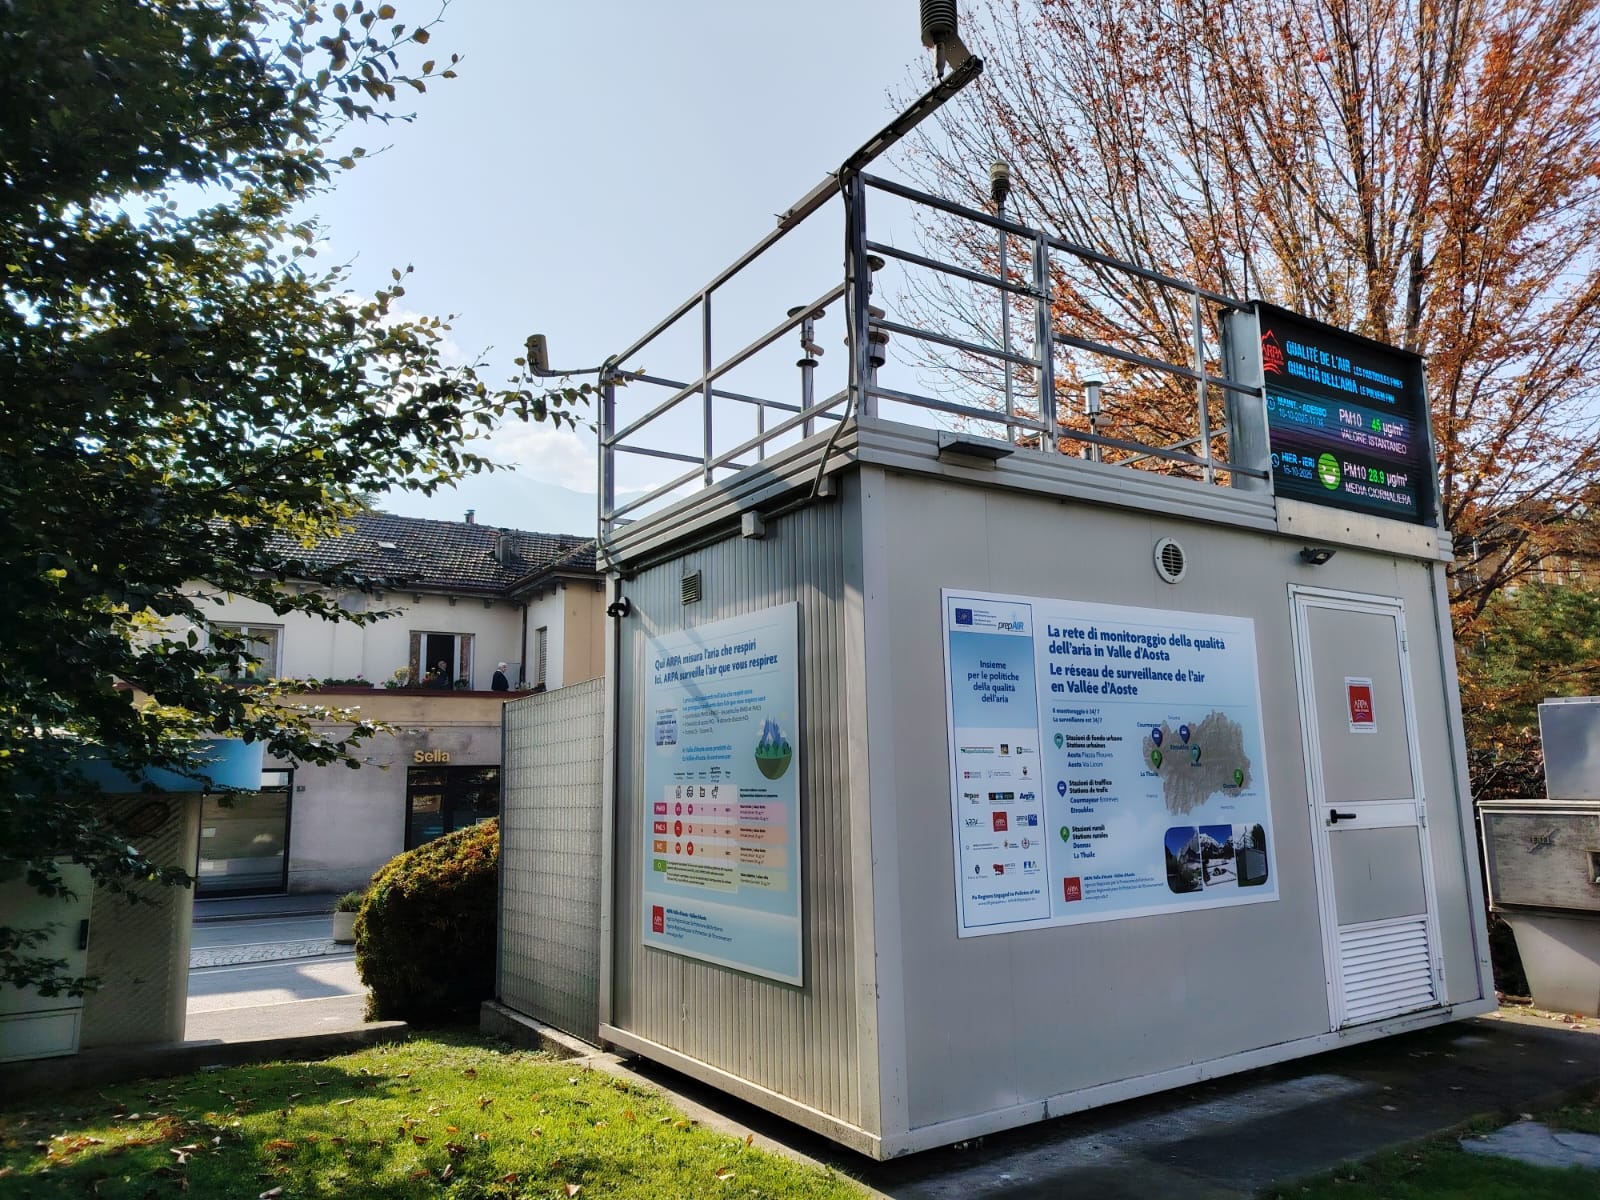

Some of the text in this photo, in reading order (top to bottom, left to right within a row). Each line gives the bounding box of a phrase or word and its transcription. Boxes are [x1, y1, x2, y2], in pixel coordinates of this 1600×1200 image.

[1286, 340, 1318, 363] QUALITÉ
[1319, 351, 1331, 366] DE
[1331, 354, 1351, 373] L'AIR
[1287, 360, 1320, 382] QUALITÀ
[1321, 372, 1358, 394] DELL'ARIA
[1339, 408, 1362, 427] PM10
[1371, 417, 1381, 432] 45
[1341, 427, 1407, 455] VALORE ISTANTANEO
[1281, 451, 1298, 465] HIER
[1302, 456, 1315, 469] IERI
[1343, 461, 1367, 480] PM10
[1368, 468, 1385, 484] 28.9
[1345, 481, 1367, 497] MEDIA
[1047, 624, 1226, 651] La rete di monitoraggio della qualità
[654, 638, 757, 671] Qui ARPA misura l'aria che respiri
[1049, 640, 1170, 662] dell'aria in Valle d'Aosta
[663, 671, 679, 683] ARPA
[679, 667, 704, 681] surveille
[705, 664, 717, 676] l'air
[718, 662, 731, 677] que
[732, 659, 748, 671] vous
[749, 653, 778, 671] respirez
[980, 660, 1007, 670] Insieme
[1049, 663, 1205, 683] Le réseau de surveillance de l'air
[968, 671, 1020, 682] per le politiche
[973, 682, 1016, 693] della qualità
[1051, 680, 1138, 696] en Vallée d'Aoste
[981, 693, 1009, 704] dell'aria
[414, 749, 450, 763] Sella
